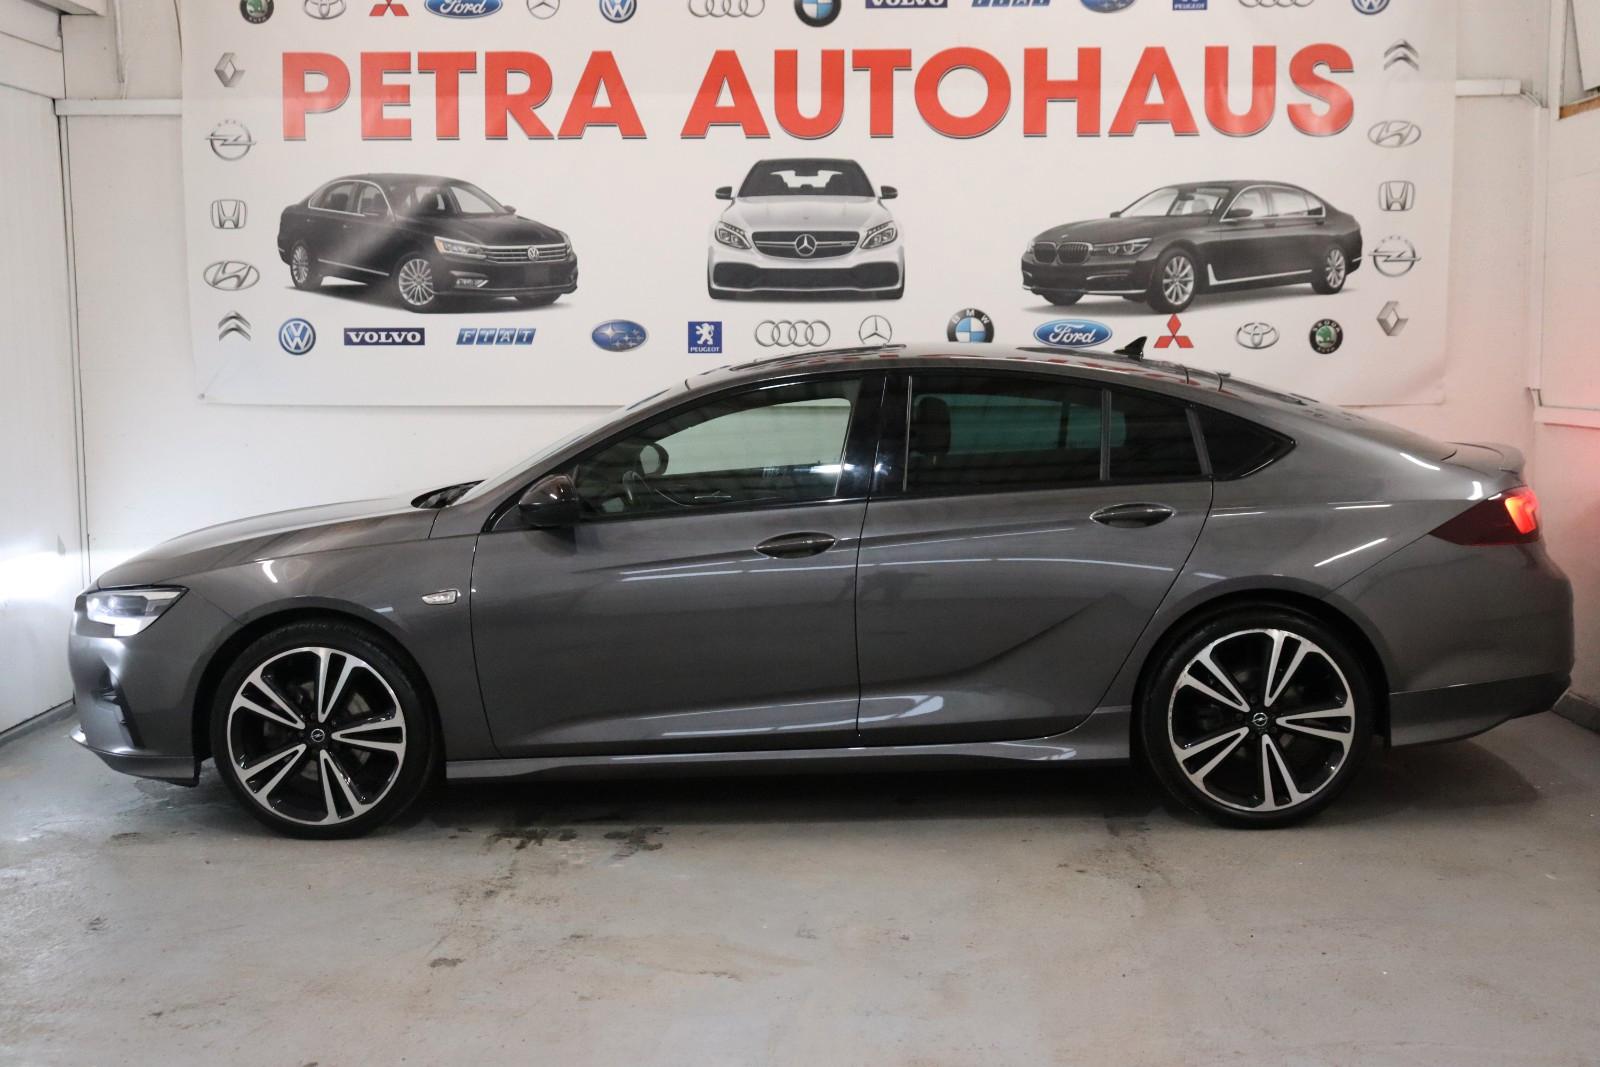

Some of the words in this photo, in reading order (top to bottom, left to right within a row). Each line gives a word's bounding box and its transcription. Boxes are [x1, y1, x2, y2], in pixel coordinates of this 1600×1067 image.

[282, 50, 647, 140] PETRA
[681, 43, 1356, 139] AUTOHAUS
[346, 331, 421, 343] VOLVO
[459, 330, 533, 343] FIAT
[1049, 323, 1096, 343] Ford
